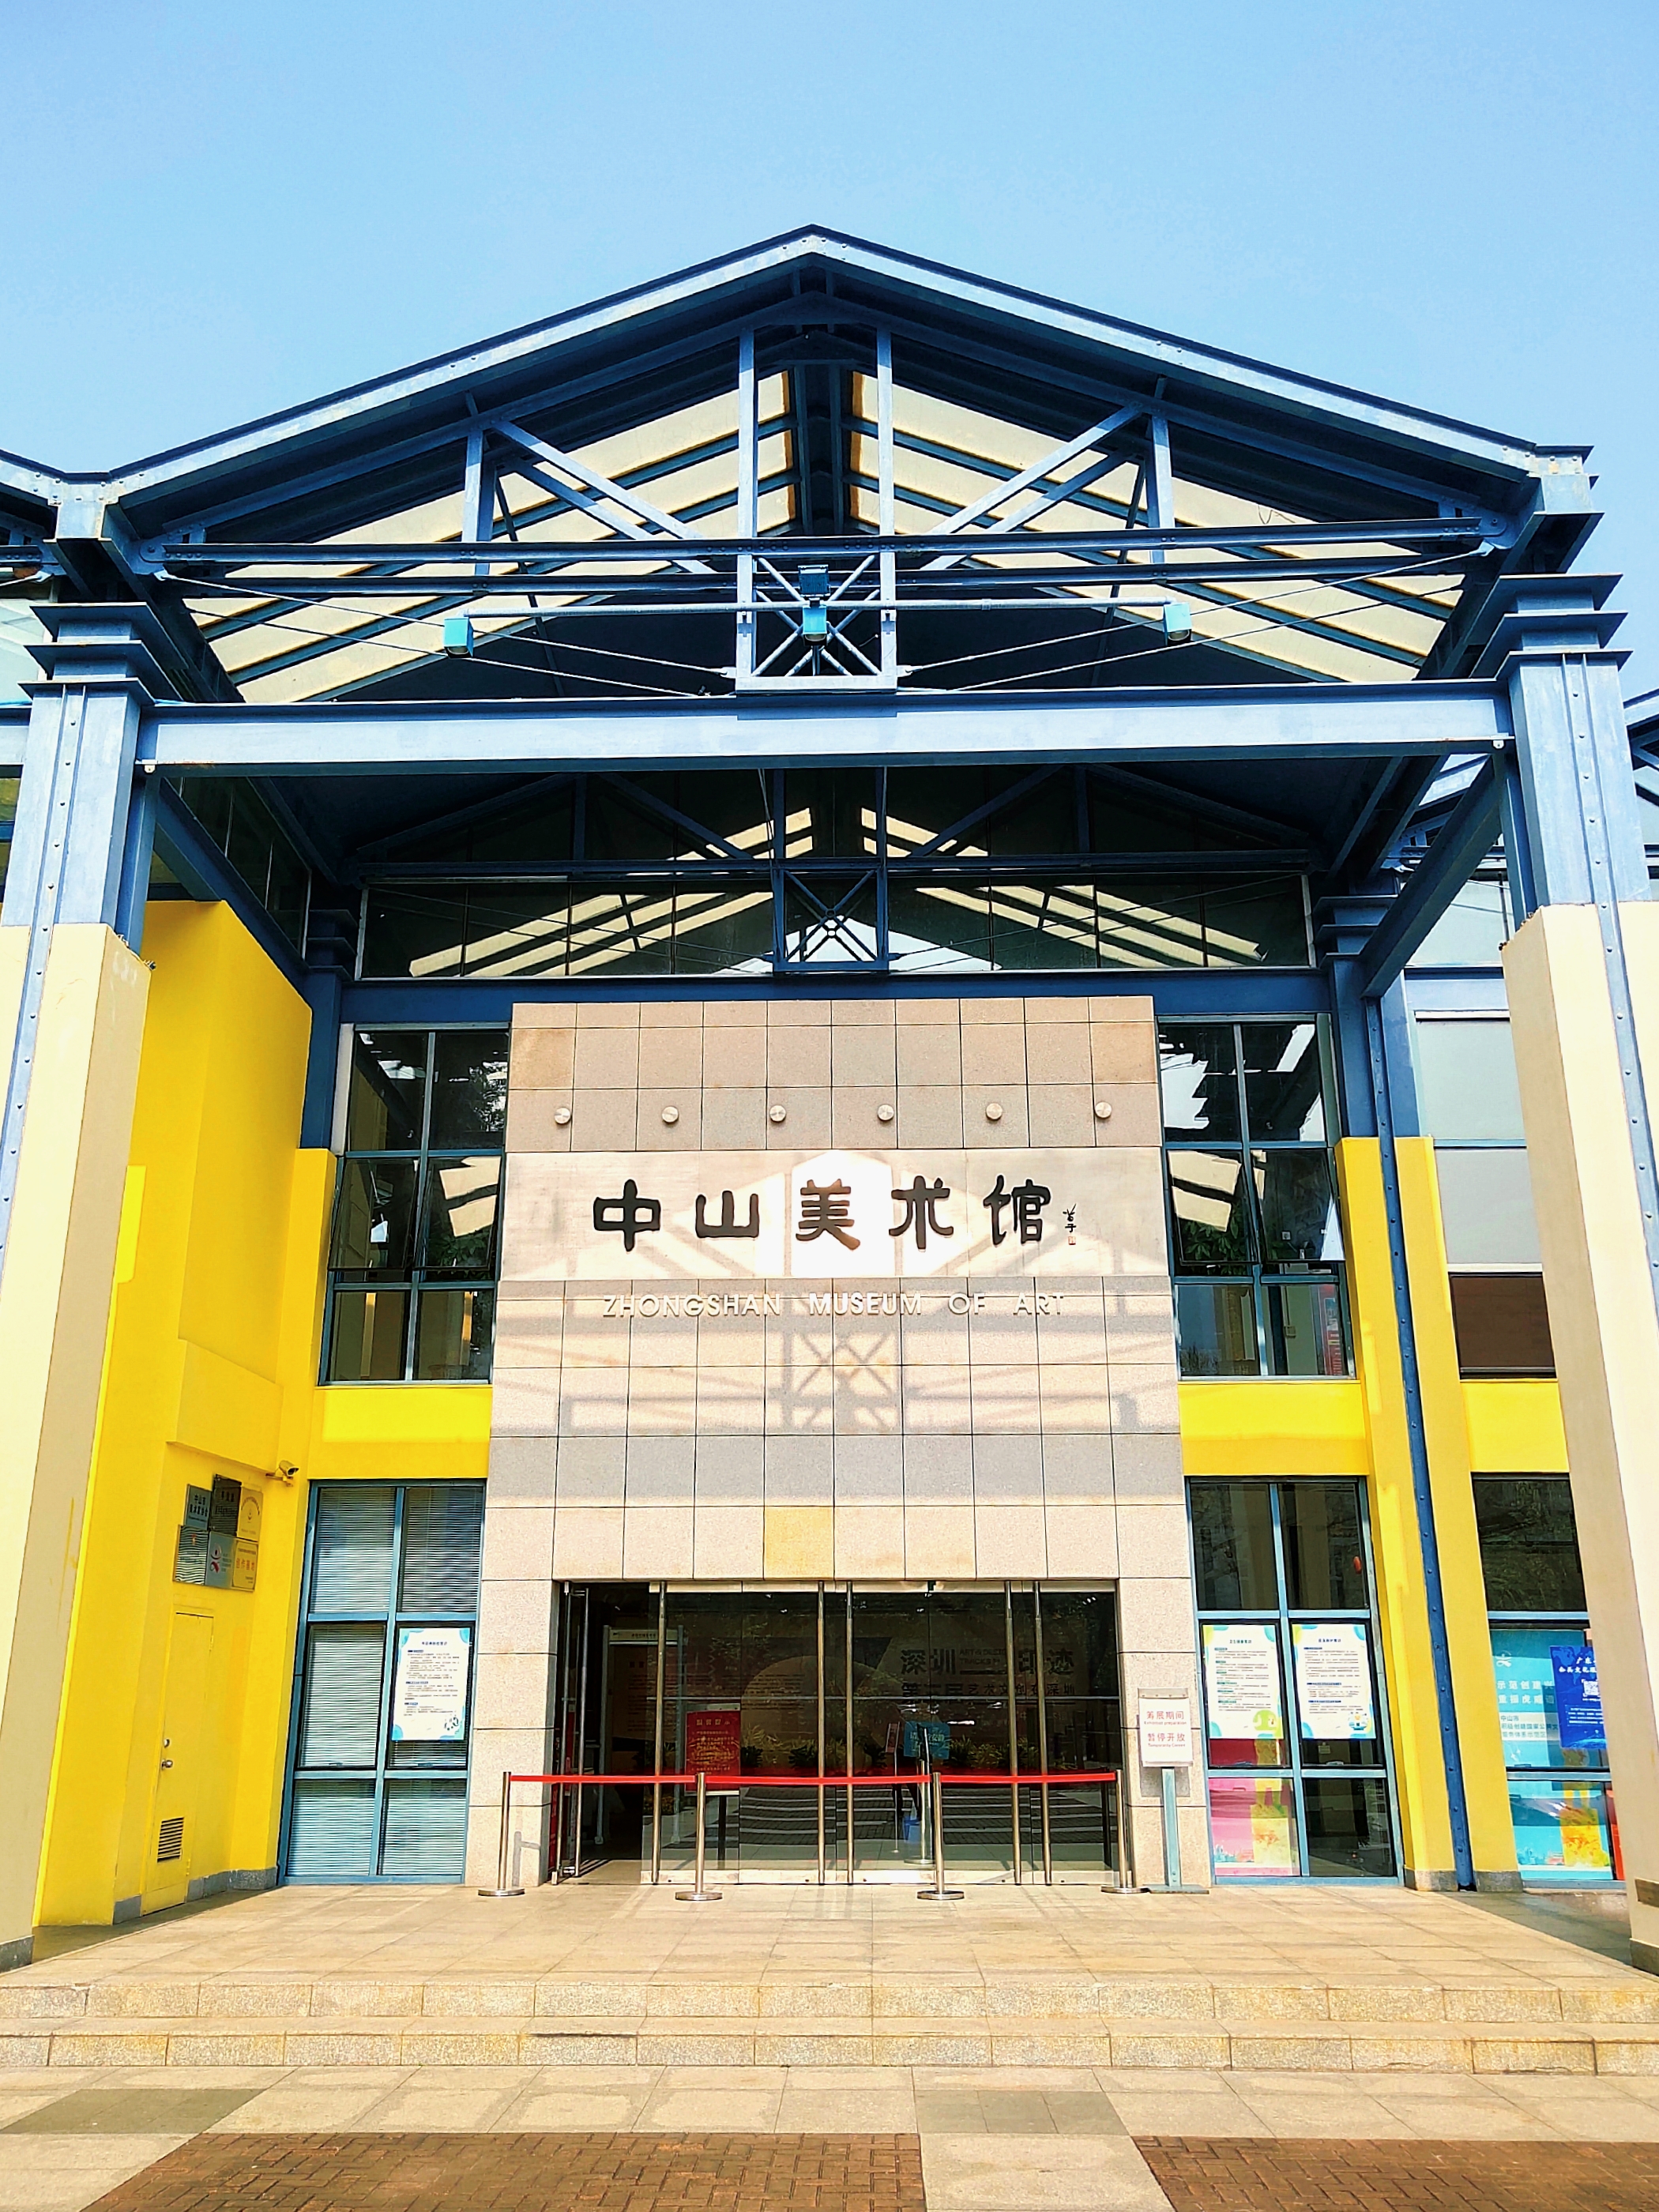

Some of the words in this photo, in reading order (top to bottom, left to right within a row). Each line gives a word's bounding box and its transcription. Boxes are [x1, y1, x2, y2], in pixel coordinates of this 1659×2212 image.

[592, 1175, 1051, 1251] 中山美术馆
[603, 1294, 781, 1317] ZHONGSHAN
[809, 1292, 922, 1315] MUSEUM
[948, 1292, 986, 1315] OF
[1013, 1291, 1065, 1315] ART
[1146, 1710, 1184, 1720] 筹展期间
[1148, 1732, 1186, 1742] 暂停开放
